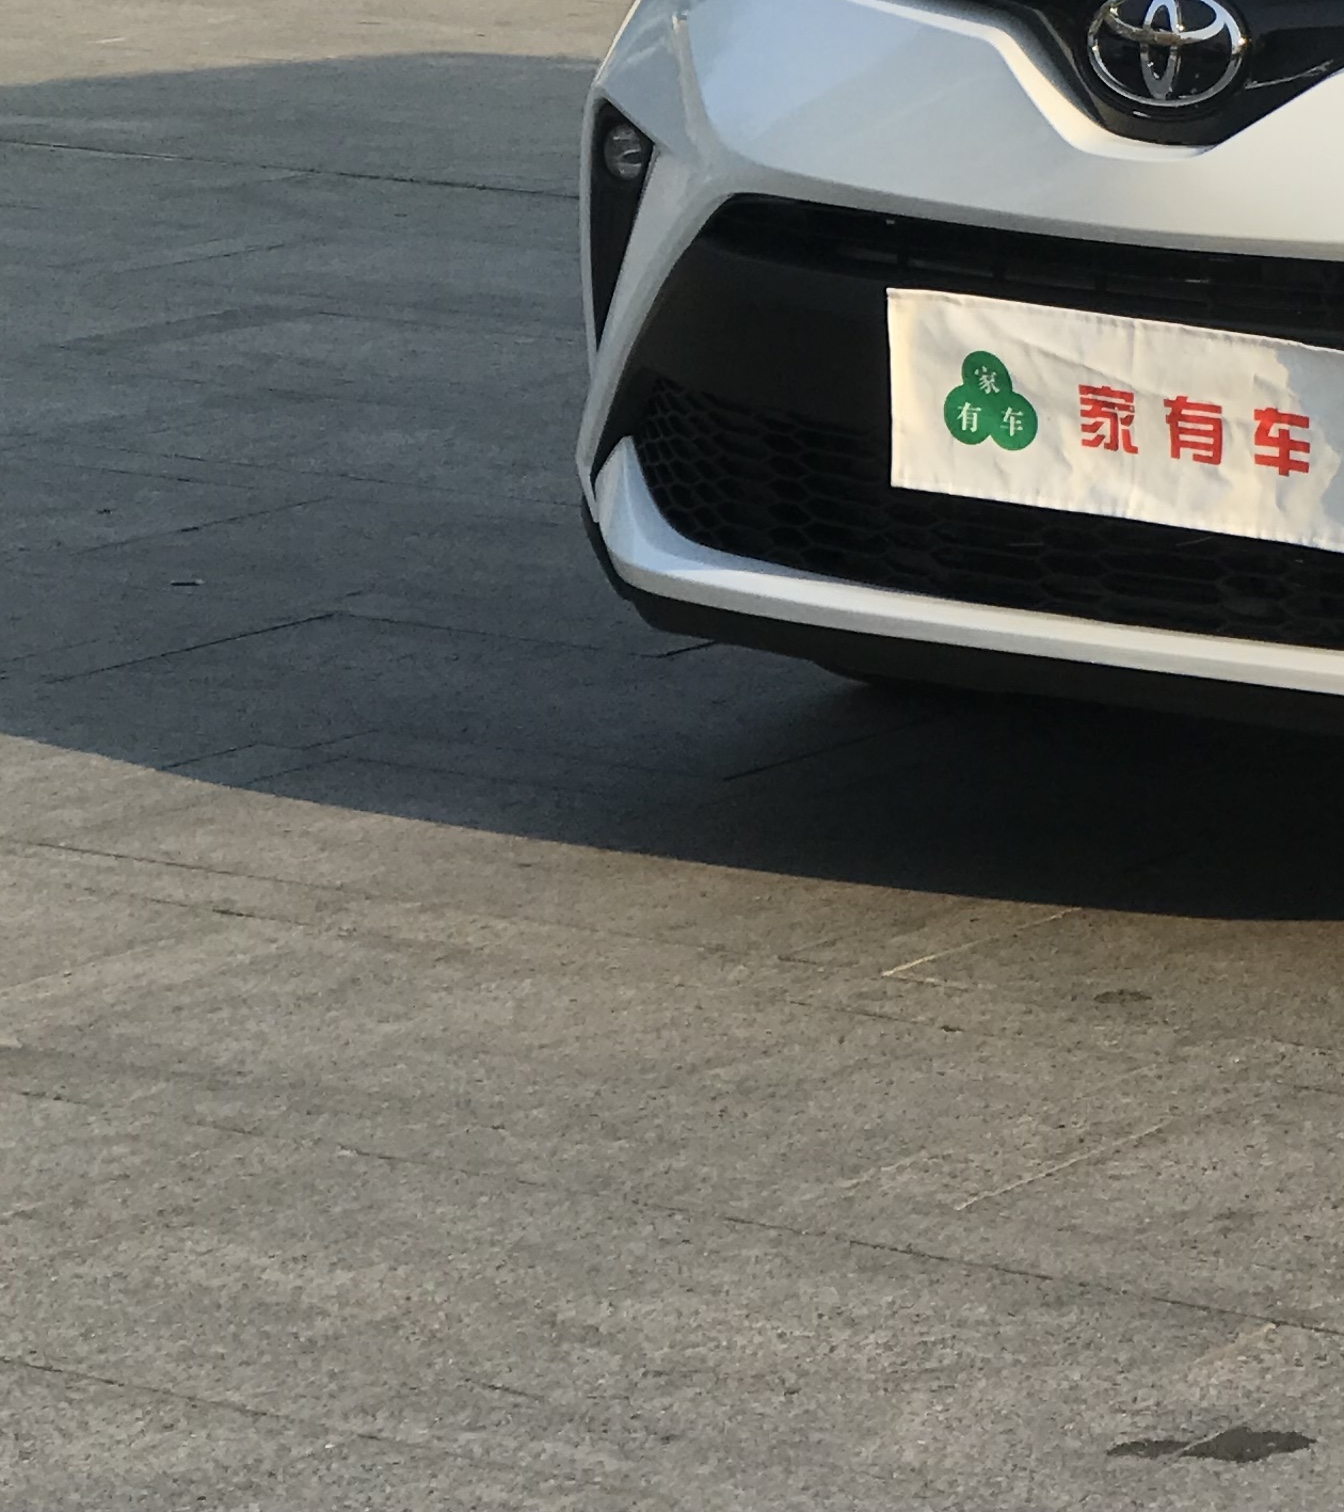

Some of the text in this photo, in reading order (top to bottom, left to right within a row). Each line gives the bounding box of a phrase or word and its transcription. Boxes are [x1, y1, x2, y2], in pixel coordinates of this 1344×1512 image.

[974, 365, 1000, 395] 家
[1078, 384, 1310, 477] 家有车
